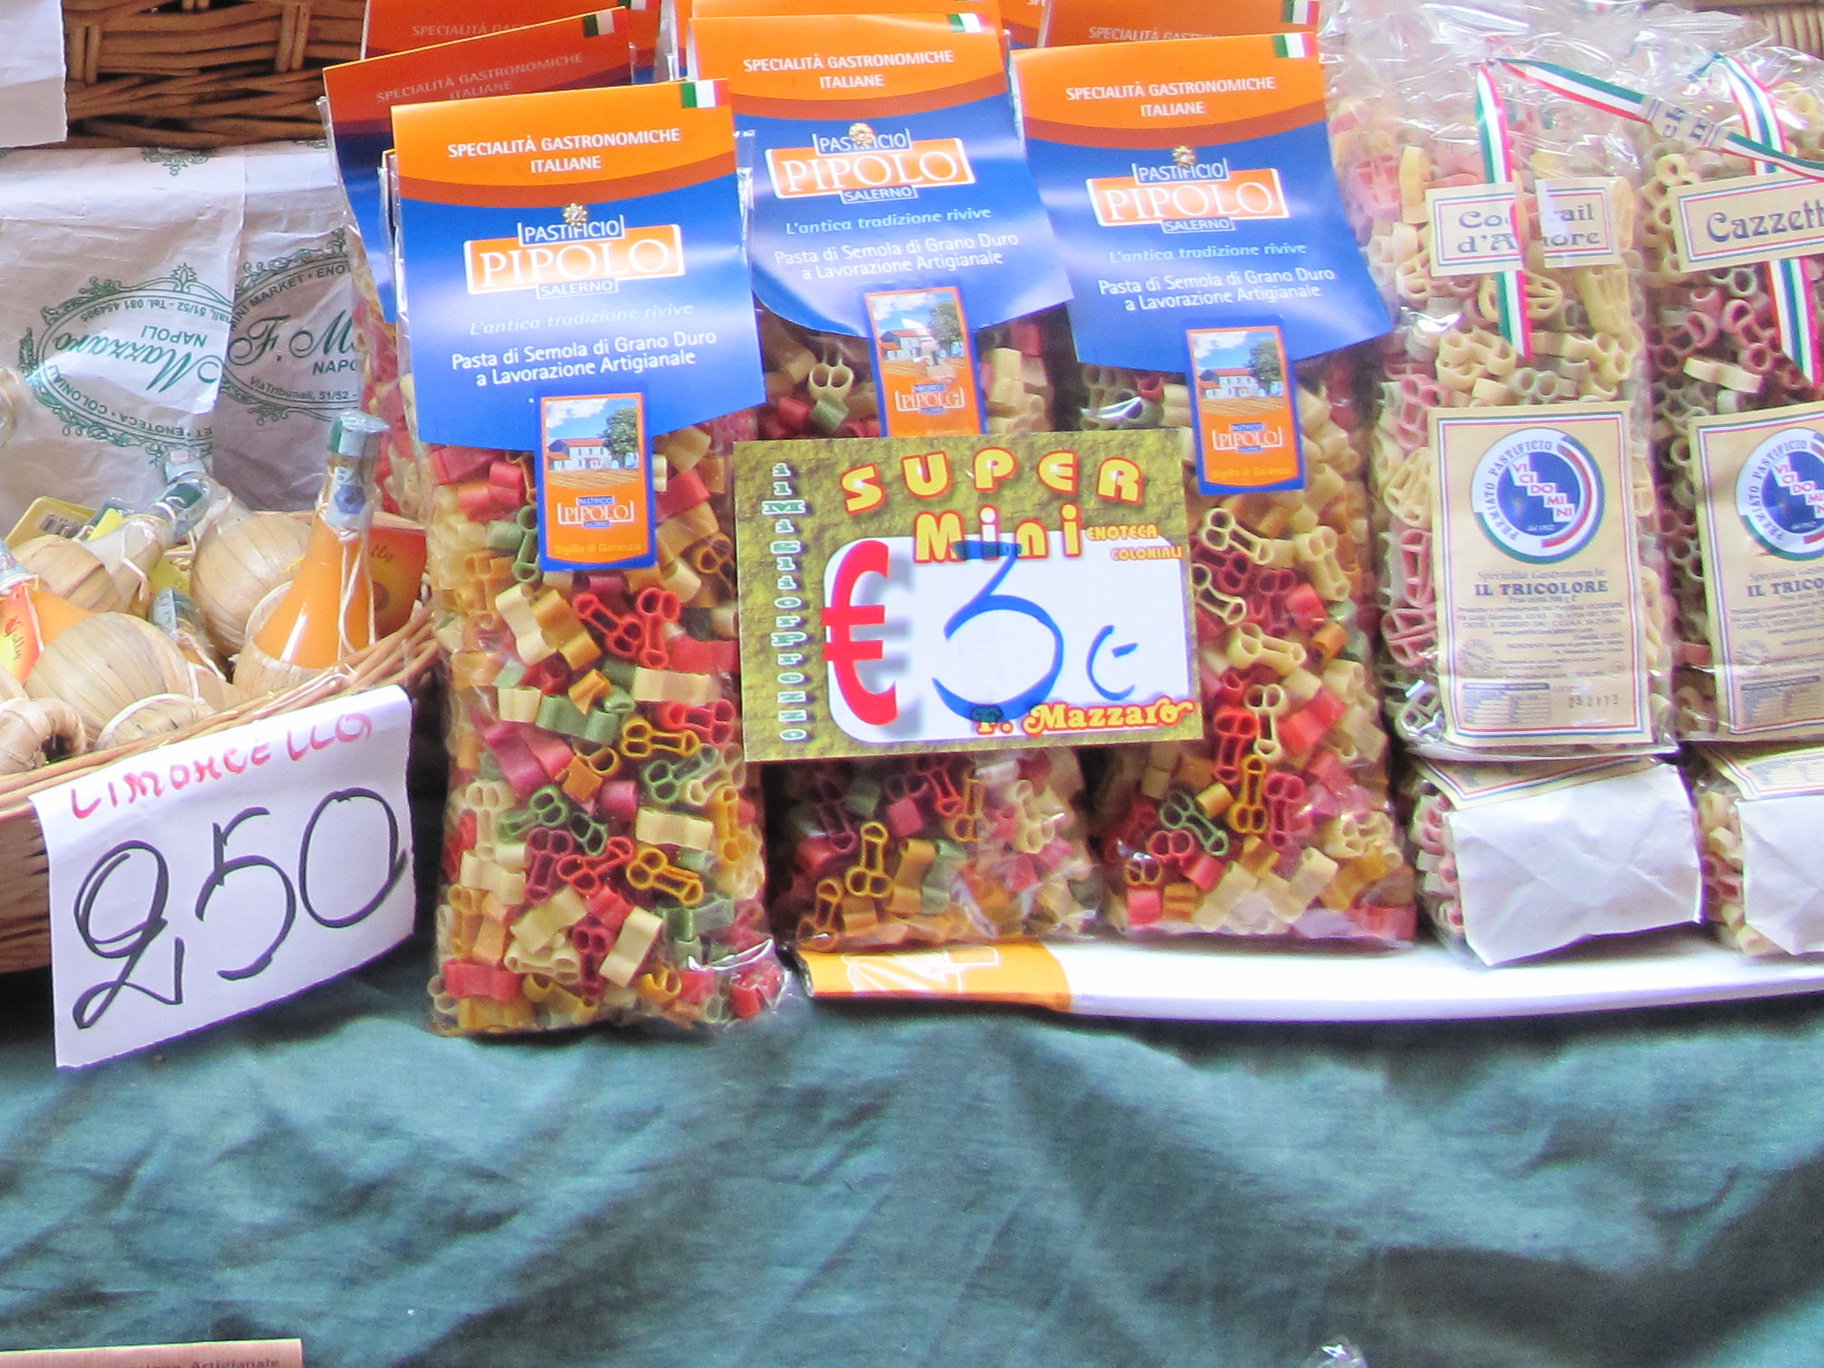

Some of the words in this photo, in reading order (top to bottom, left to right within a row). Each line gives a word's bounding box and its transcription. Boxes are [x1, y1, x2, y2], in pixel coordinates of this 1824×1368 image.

[742, 53, 824, 73] SPECIALITÀ
[826, 49, 955, 69] GASTRONOMICHE
[377, 75, 455, 103] SPECIALITÀ
[458, 52, 584, 88] GASTRONOMICHE
[819, 73, 885, 90] ITALIANE
[1066, 81, 1147, 102] SPECIALITÀ
[1148, 75, 1276, 98] GASTRONOMICHE
[1139, 100, 1206, 118] ITALIANE
[447, 134, 538, 159] SPECIALITÀ
[540, 128, 681, 152] GASTRONOMICHE
[530, 155, 602, 174] ITALIANE
[781, 150, 959, 194] PIPOLO
[1139, 161, 1225, 182] PASTIFICIO
[843, 186, 913, 203] SALERNO
[1102, 179, 1275, 222] PIPOLO
[524, 219, 621, 243] PASTIFICIO
[785, 217, 853, 237] L'antica
[857, 211, 943, 229] tradizione
[945, 205, 992, 223] rivive
[1164, 217, 1232, 234] SALERNO
[774, 247, 818, 265] Pasta
[822, 246, 839, 263] di
[842, 241, 903, 260] Semola
[905, 238, 922, 256] di
[924, 235, 976, 254] Grano
[979, 232, 1020, 248] Duro
[1109, 246, 1175, 265] L'antica
[1178, 242, 1261, 259] tradizione
[1263, 239, 1308, 256] rivive
[478, 239, 671, 289] PIPOLO
[815, 257, 914, 280] Lavorazione
[916, 250, 1004, 273] Artigianale
[539, 278, 614, 298] SALERNO
[1098, 278, 1143, 297] Pasta
[1146, 276, 1161, 294] di
[1164, 272, 1224, 292] Semola
[1226, 270, 1242, 288] di
[1244, 267, 1294, 285] Grano
[1297, 265, 1336, 282] Duro
[1138, 289, 1234, 311] Lavorazione
[1237, 283, 1322, 305] Artigianale
[469, 314, 542, 338] L'antica
[546, 307, 643, 330] tradizione
[644, 301, 695, 319] rivive
[140, 324, 209, 348] NAPOLI
[451, 348, 499, 372] Pasta
[502, 347, 520, 366] di
[523, 341, 590, 364] Semola
[593, 339, 611, 358] di
[614, 333, 670, 355] Grano
[673, 329, 718, 347] Duro
[53, 332, 225, 393] Mazzaro
[491, 359, 597, 387] Lavorazione
[600, 349, 697, 379] Artigianale
[136, 414, 185, 438] ENOTECA
[1489, 440, 1554, 477] PASTIFICIO
[1752, 439, 1808, 480] PASTIFICIO
[840, 446, 1145, 515] SUPER
[563, 504, 630, 522] PIPOLO
[1484, 482, 1518, 542] PREMIATO
[913, 502, 1083, 565] Mini
[1085, 523, 1160, 542] ENOTECA
[1475, 584, 1494, 597] IL
[1500, 580, 1609, 597] TRICOLORE
[1747, 585, 1766, 597] IL
[821, 539, 899, 726] €
[931, 539, 1065, 724] 3
[1022, 697, 1195, 738] Mazzaro
